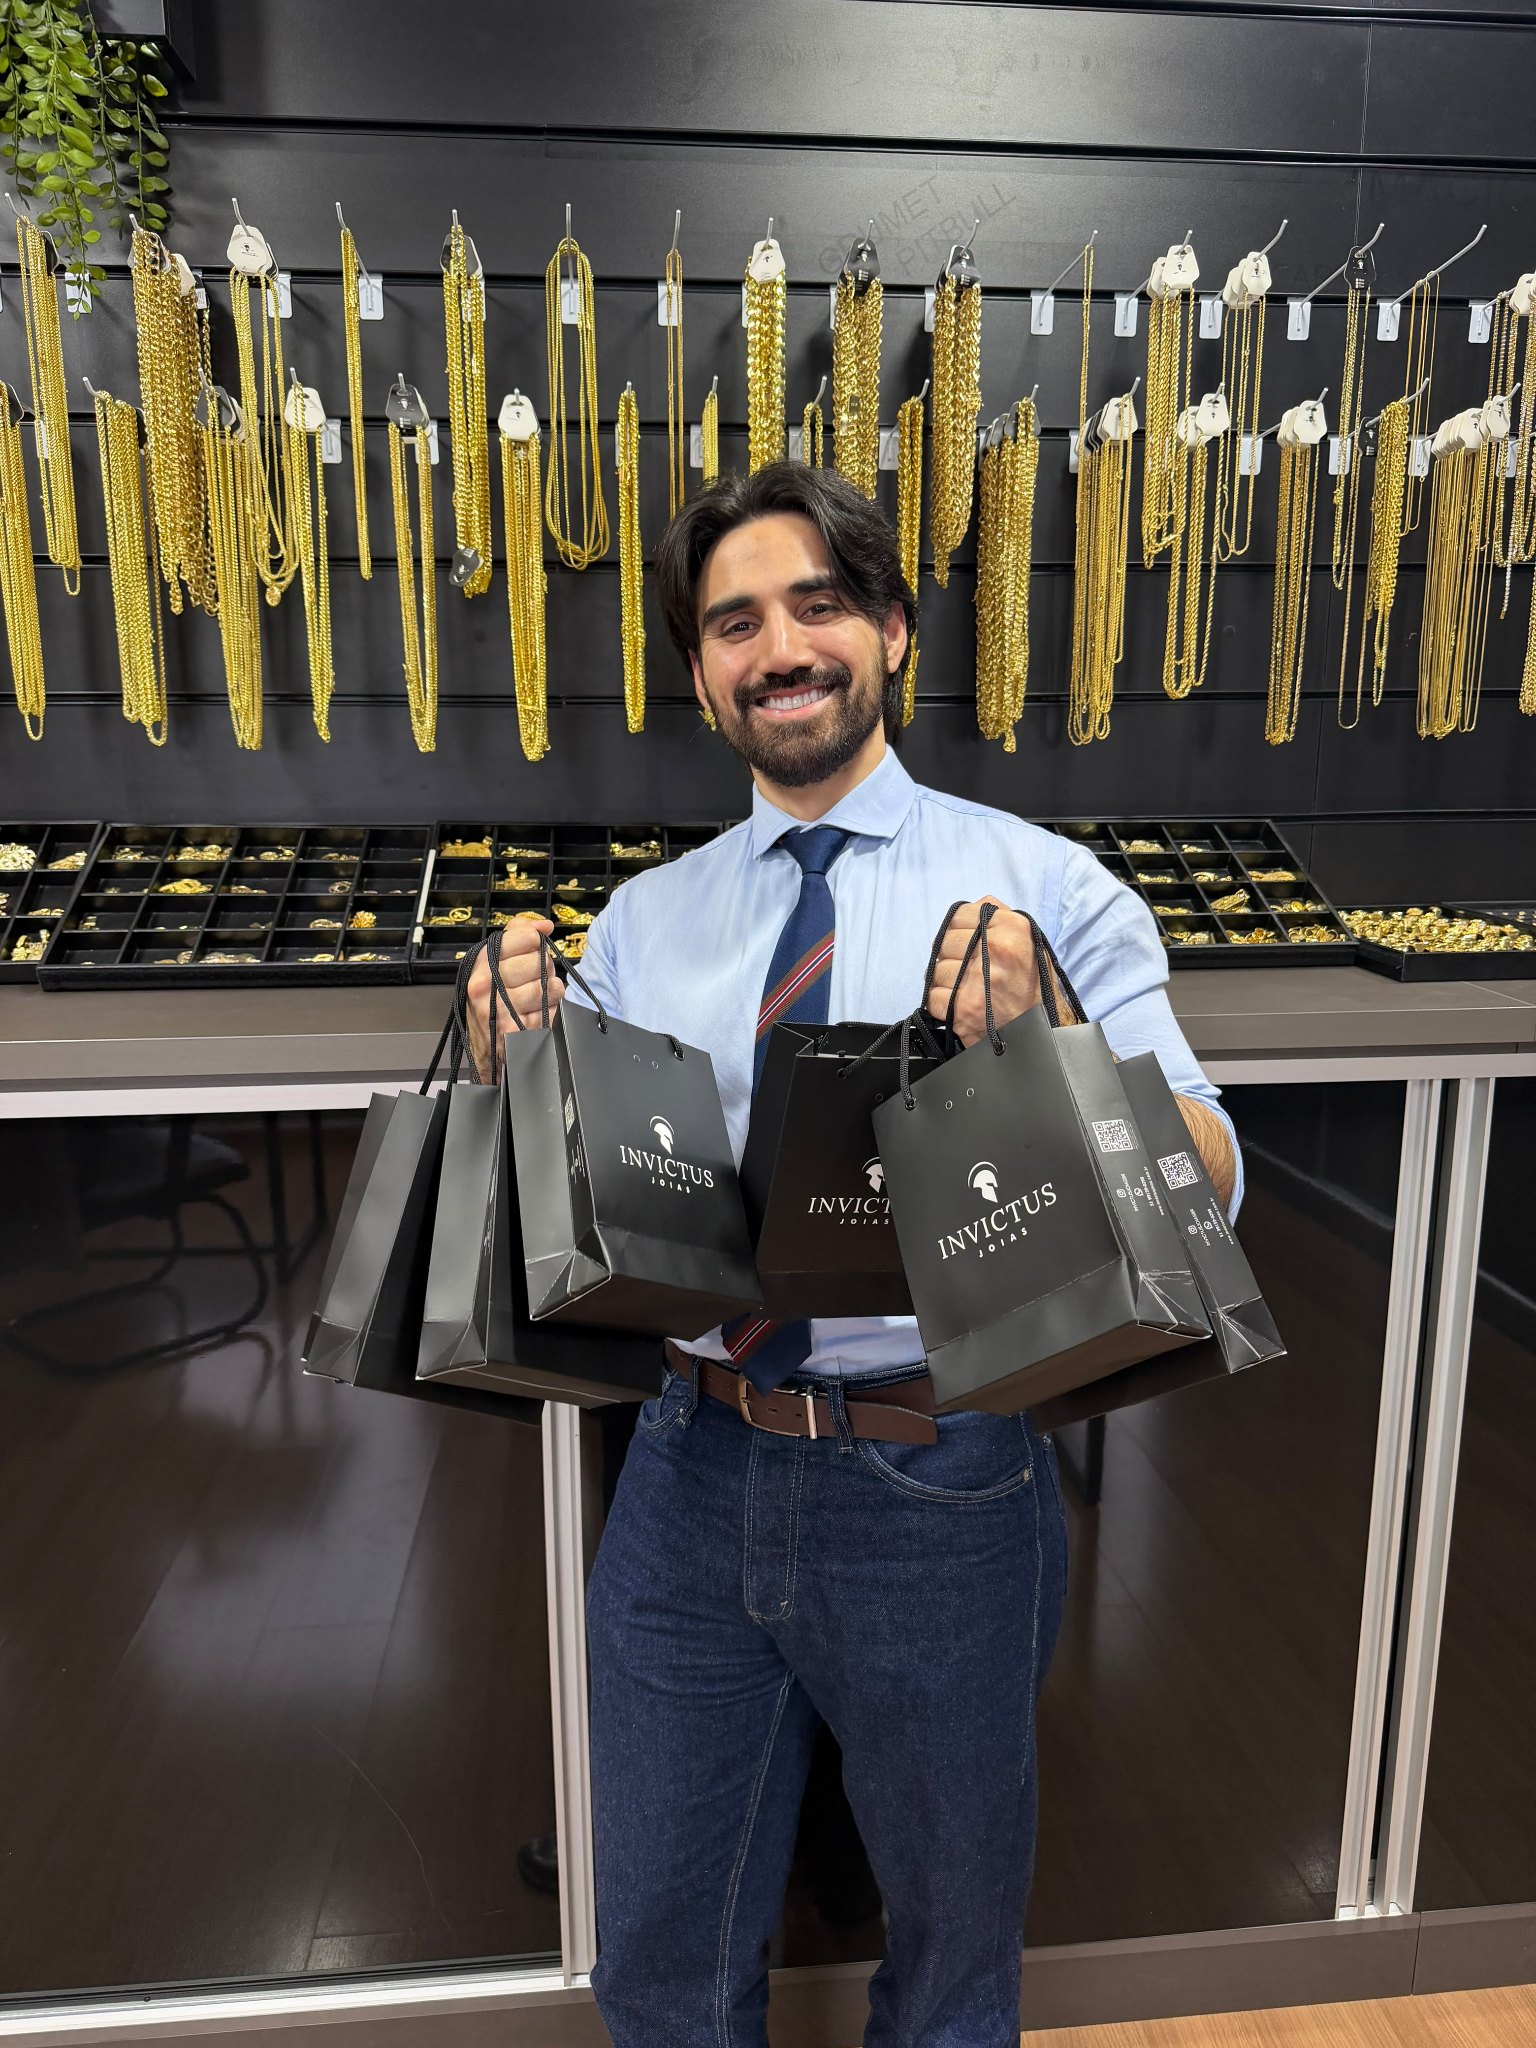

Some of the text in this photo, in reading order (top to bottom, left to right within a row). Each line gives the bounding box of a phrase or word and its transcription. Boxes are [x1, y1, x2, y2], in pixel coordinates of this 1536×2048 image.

[619, 1144, 715, 1188] INVICTUS
[651, 1176, 692, 1194] JOIAS
[936, 1182, 1058, 1261] INVICTUS
[977, 1227, 1029, 1259] JOIAS
